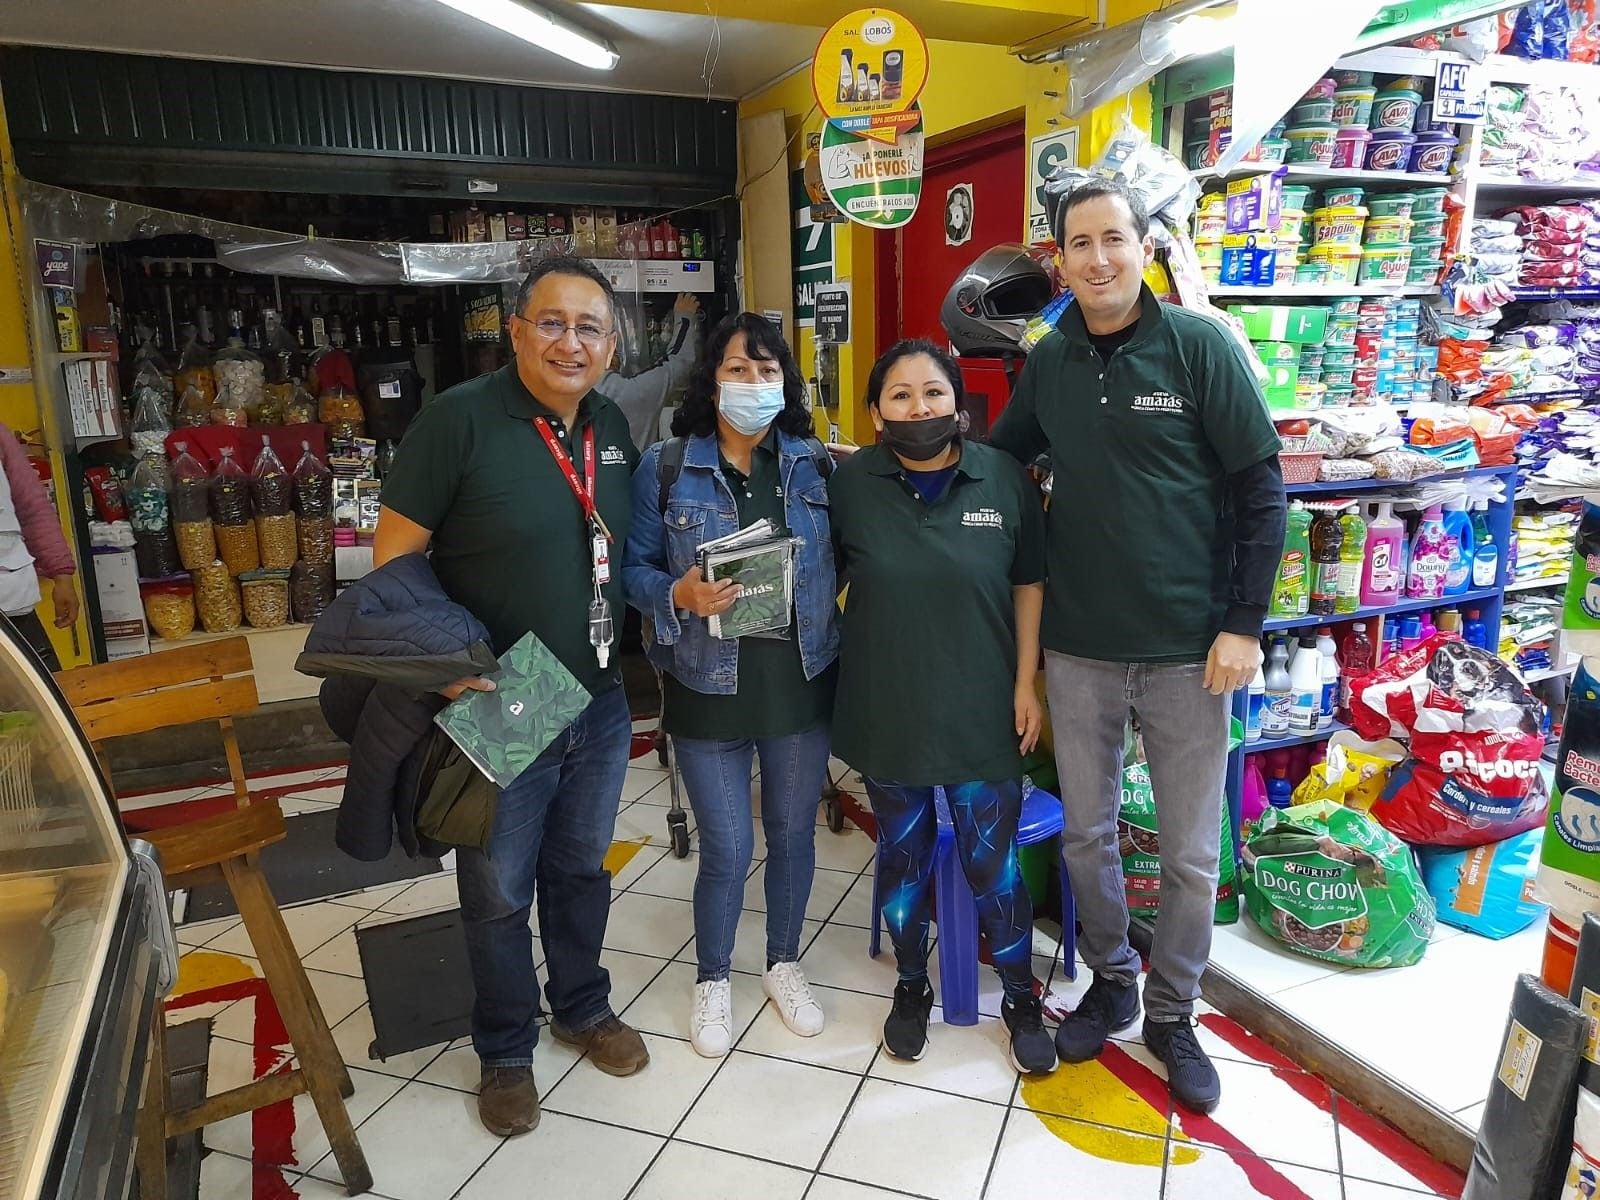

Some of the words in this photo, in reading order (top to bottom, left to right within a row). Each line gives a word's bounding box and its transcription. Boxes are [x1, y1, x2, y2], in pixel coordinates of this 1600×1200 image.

[864, 26, 893, 36] LOBOS
[1382, 107, 1409, 120] LAVA
[841, 119, 853, 128] CON
[853, 117, 870, 127] DOBLE
[871, 115, 884, 125] TAPA
[873, 148, 903, 159] PONERLE
[1373, 149, 1400, 165] LAVA
[853, 159, 911, 179] HUEVOS!
[1319, 223, 1357, 240] Sapolio
[831, 431, 836, 443] 2
[1416, 562, 1446, 574] Downy
[1567, 751, 1600, 773] Remu
[1563, 764, 1600, 787] Bacte
[1476, 803, 1512, 814] cereales
[1572, 839, 1600, 853] Limpia
[1296, 865, 1342, 877] PURINA
[1262, 870, 1301, 896] DOG
[1337, 904, 1358, 914] mejor
